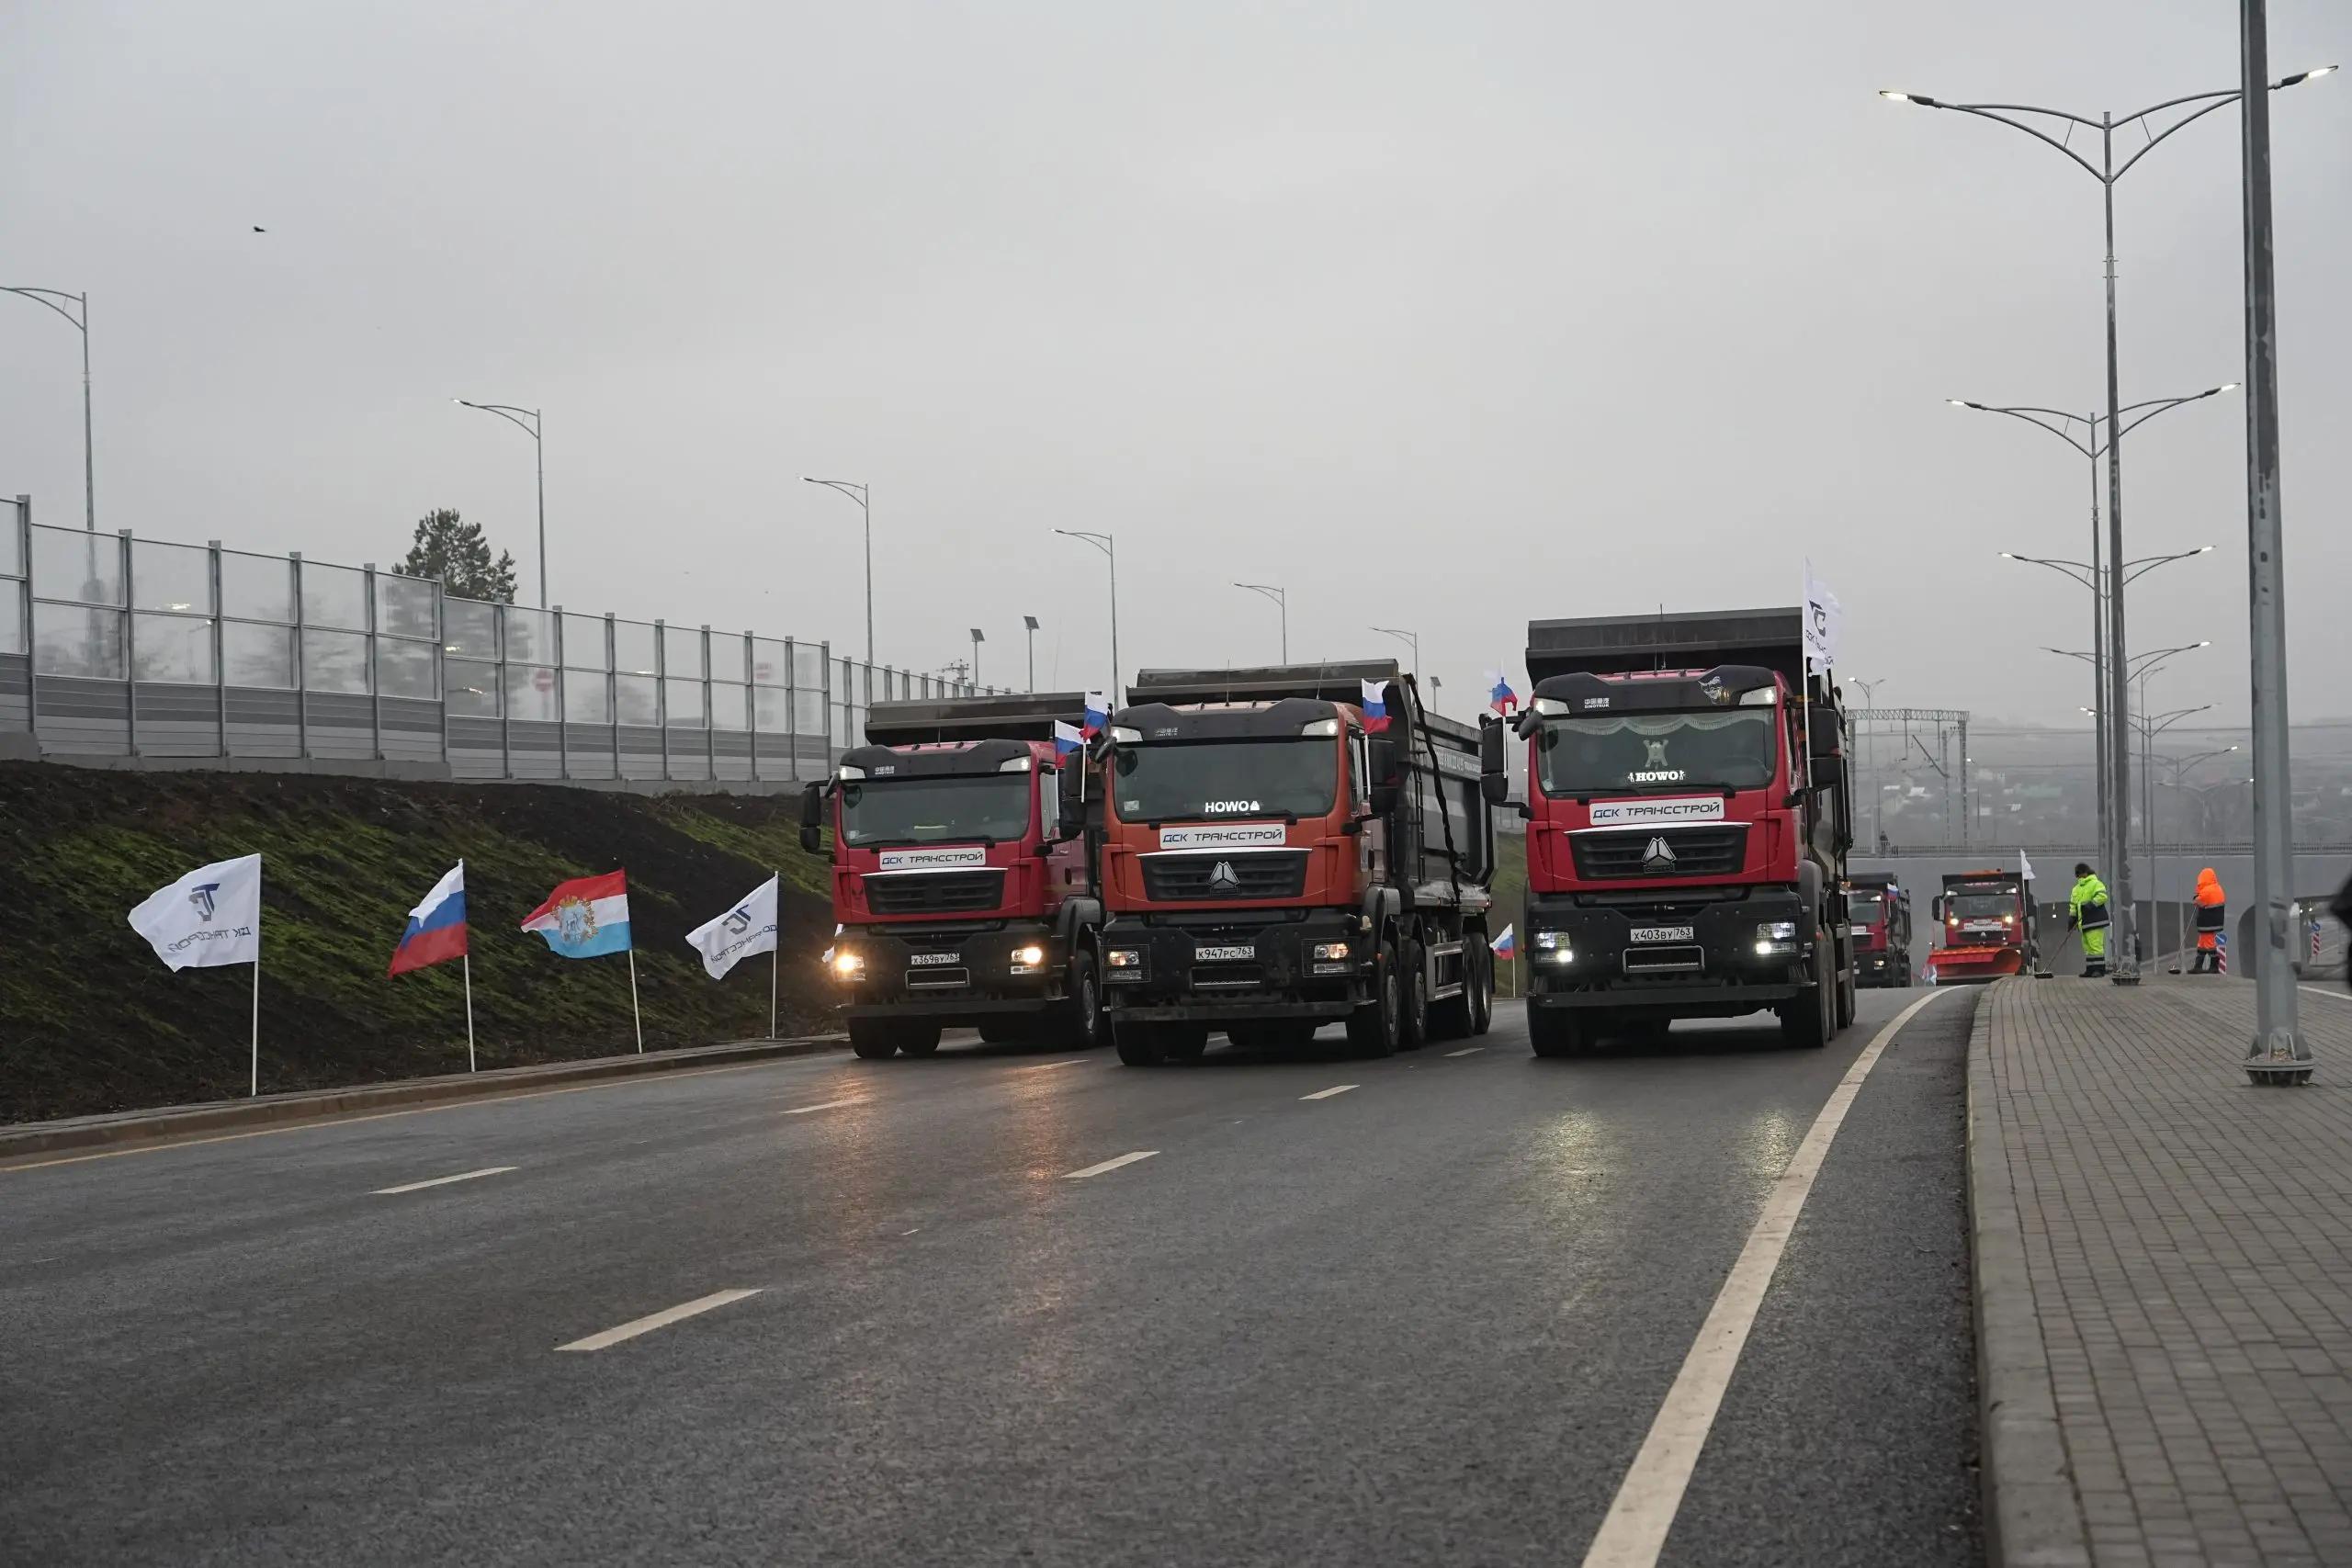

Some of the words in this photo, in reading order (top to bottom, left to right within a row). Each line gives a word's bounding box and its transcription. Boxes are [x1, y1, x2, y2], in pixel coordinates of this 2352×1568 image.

[1635, 771, 1679, 782] HOWO
[1204, 800, 1250, 813] HOWO
[1593, 808, 1620, 819] ДСК
[1625, 801, 1721, 817] ТРАНССТРОЙ
[1162, 833, 1188, 843] ДСК
[1194, 829, 1283, 841] ТРАНССТРОЙ
[882, 856, 904, 865] ДСК
[909, 851, 984, 863] ТРАНССТРОЙ
